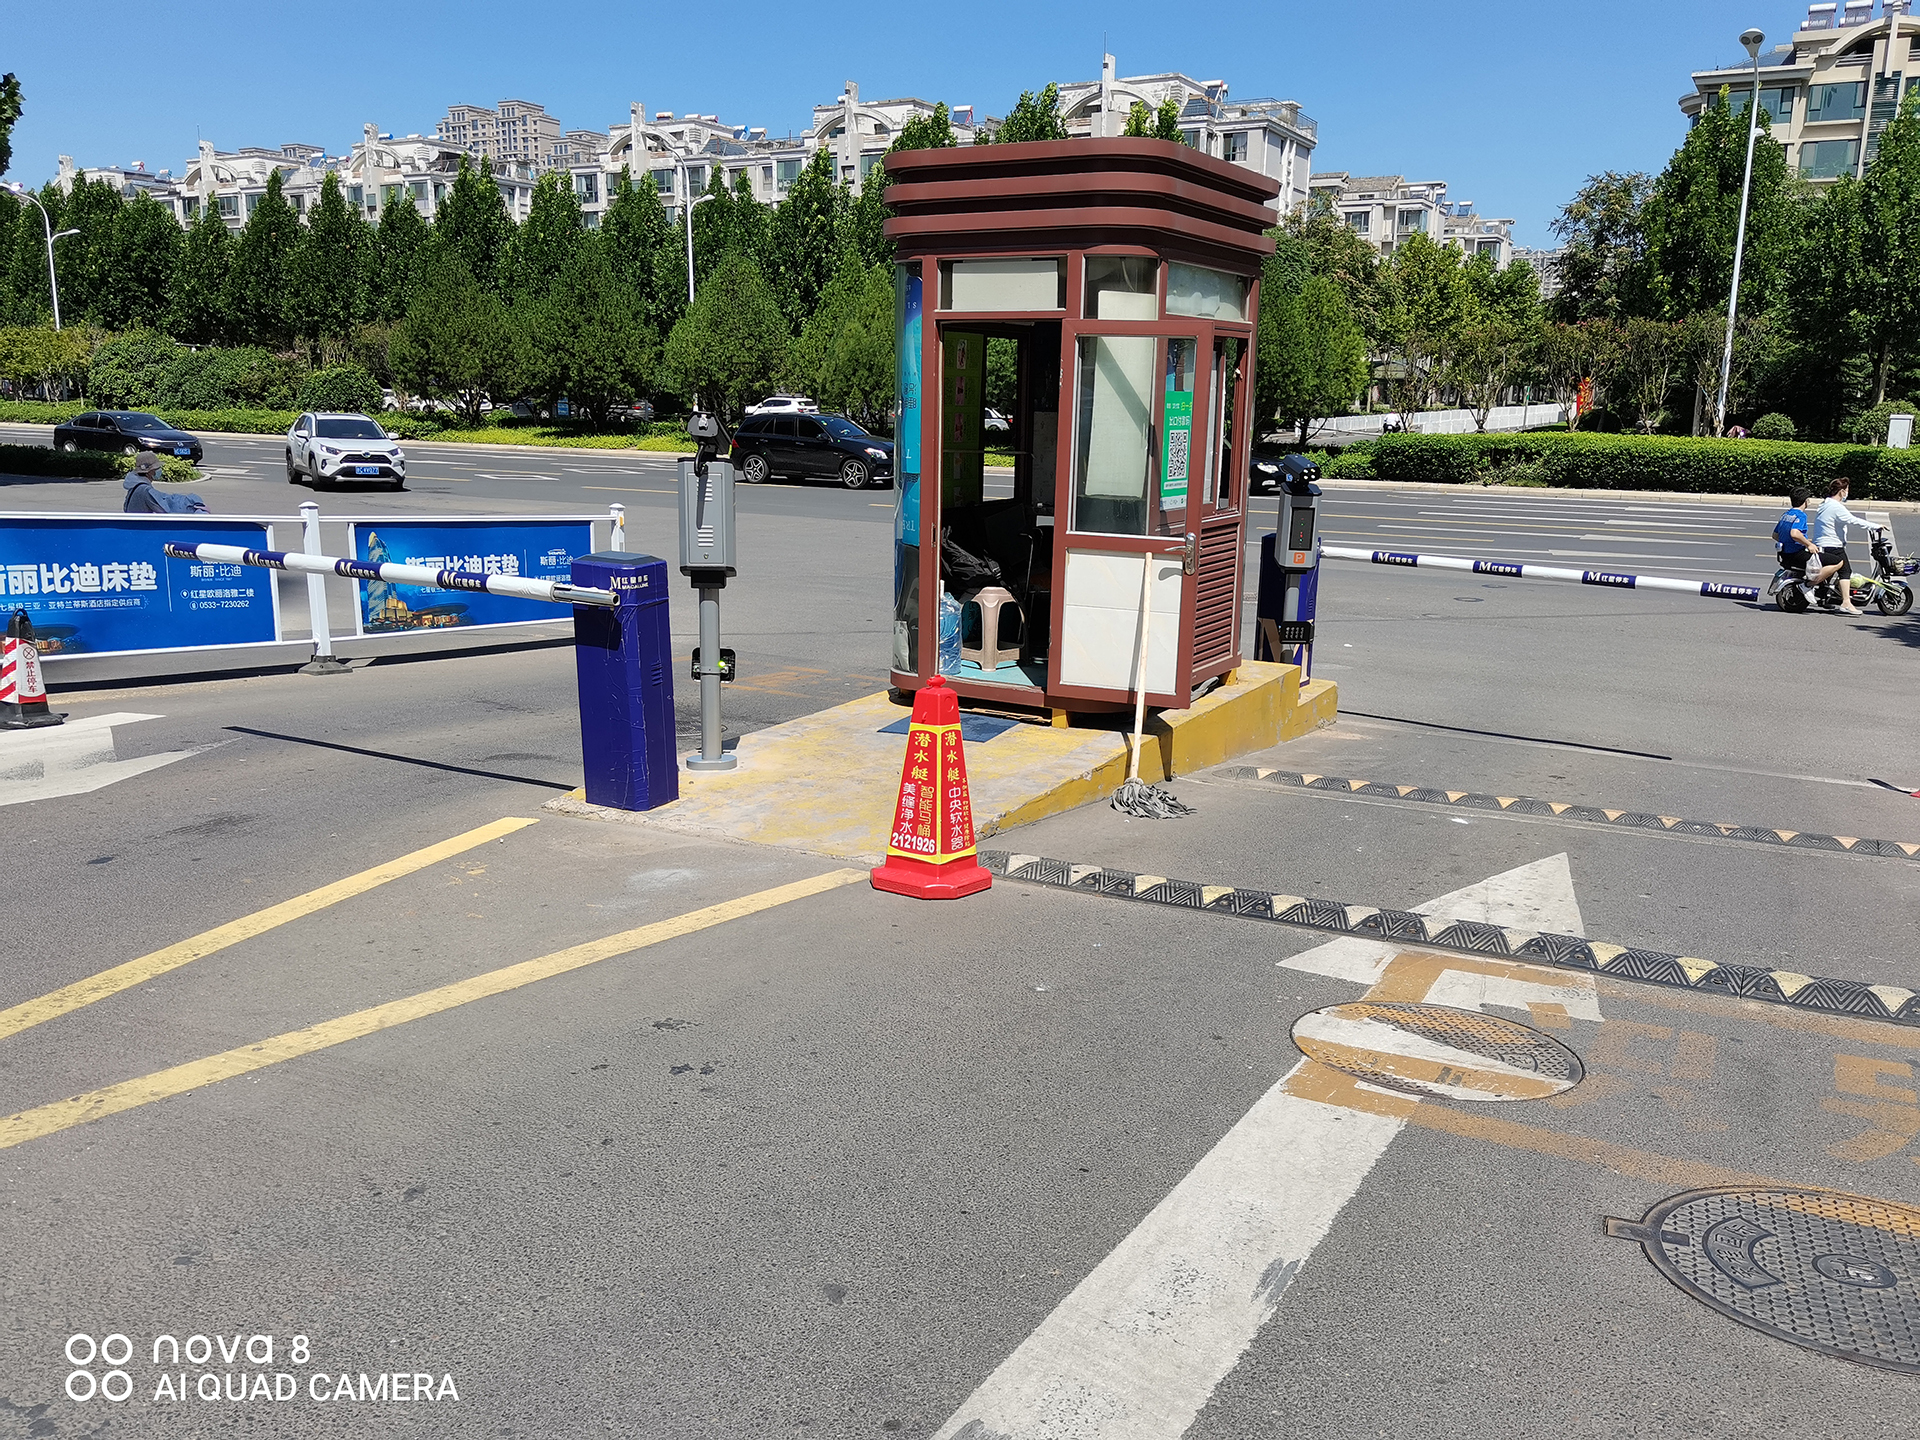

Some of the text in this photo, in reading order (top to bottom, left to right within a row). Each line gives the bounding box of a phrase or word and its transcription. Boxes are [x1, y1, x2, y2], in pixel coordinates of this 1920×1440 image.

[199, 600, 250, 609] 0533-7230262
[26, 661, 38, 694] 禁止停车
[948, 787, 964, 851] 中央软水器
[891, 832, 936, 853] 2121926
